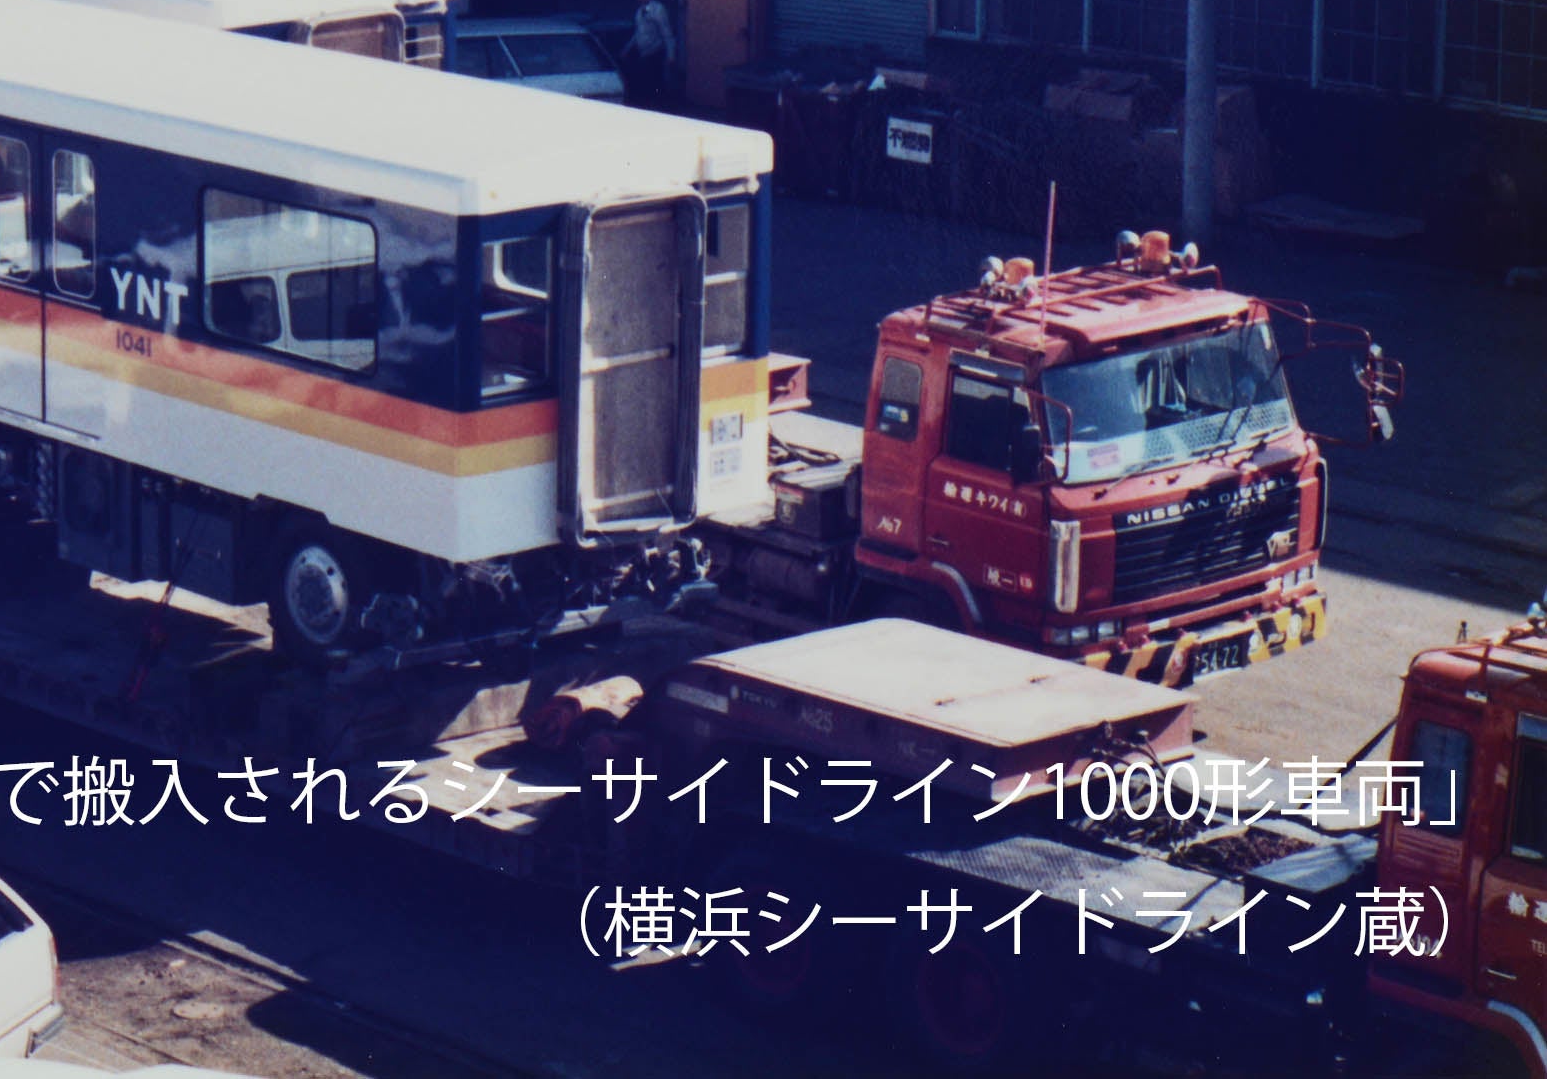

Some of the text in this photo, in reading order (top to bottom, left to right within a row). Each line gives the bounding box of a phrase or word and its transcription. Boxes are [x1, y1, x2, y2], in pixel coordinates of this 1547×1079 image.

[110, 266, 189, 325] YNT
[116, 328, 152, 358] 1041
[1126, 498, 1210, 526] NISSAN
